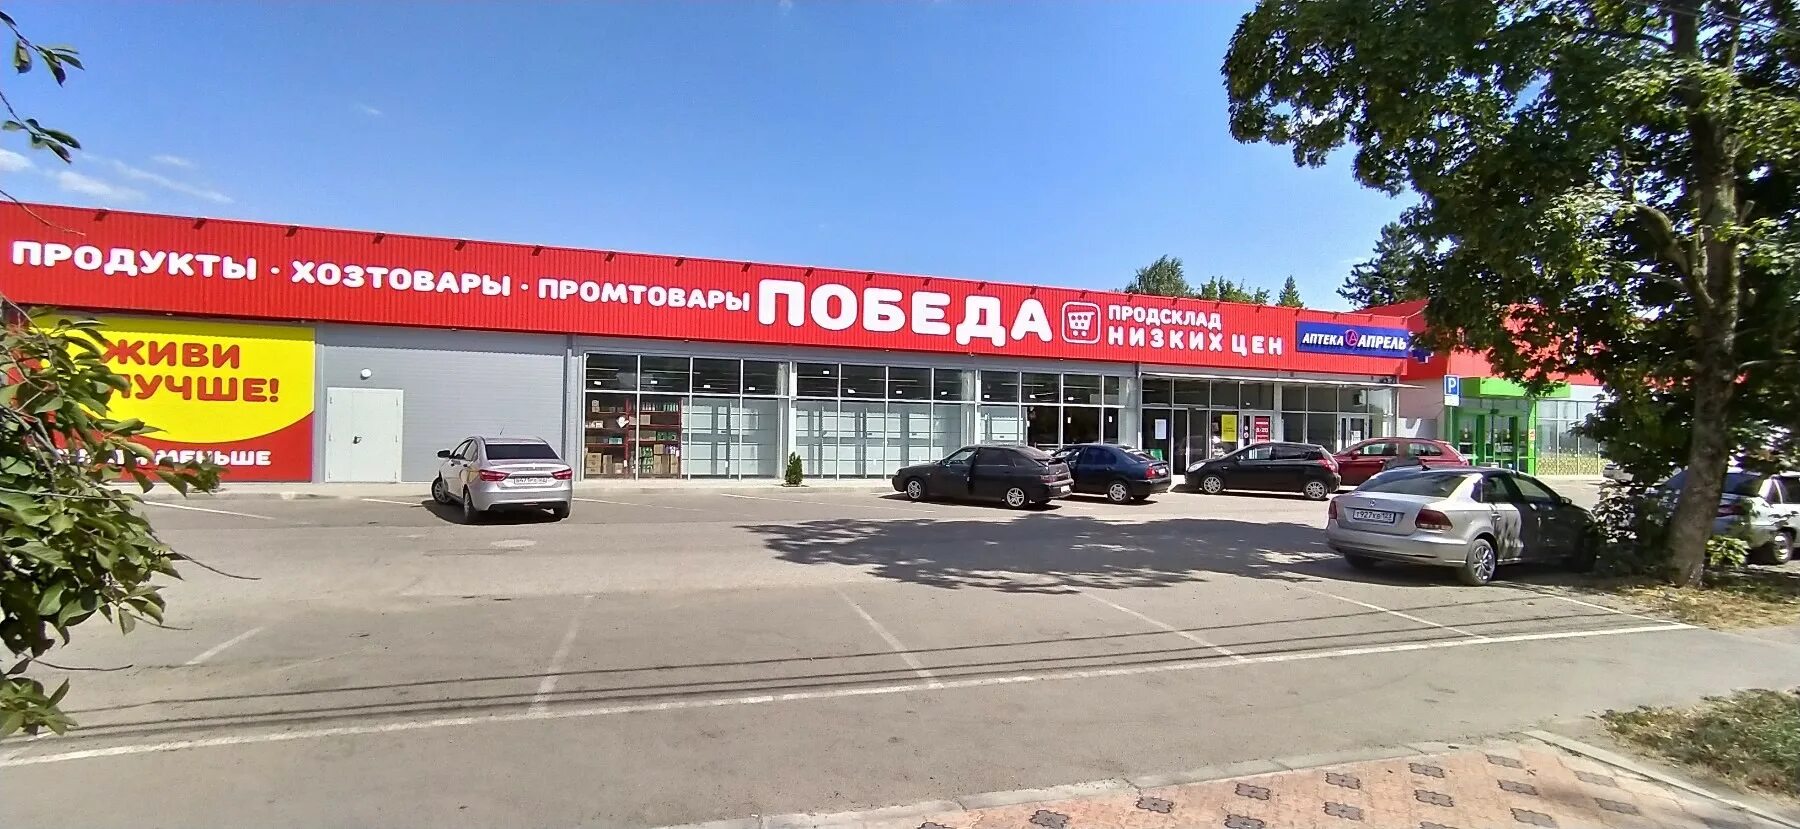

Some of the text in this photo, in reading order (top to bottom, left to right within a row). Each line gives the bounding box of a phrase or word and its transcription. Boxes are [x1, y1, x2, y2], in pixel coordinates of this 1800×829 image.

[12, 240, 752, 313] ПРОДУКТЫ ХОЗТОВАРЫ ПРОМТОВАРЫ
[758, 279, 1053, 347] ПОБЕДА
[1108, 304, 1222, 331] ПРОДСКЛАД
[101, 339, 240, 369] ЖИВИ
[1108, 325, 1283, 357] НИЗКИХ ЦЕН
[1302, 332, 1344, 347] АПТЕКА
[1357, 334, 1407, 350] АПРЕЛЬ
[1448, 377, 1457, 393] P
